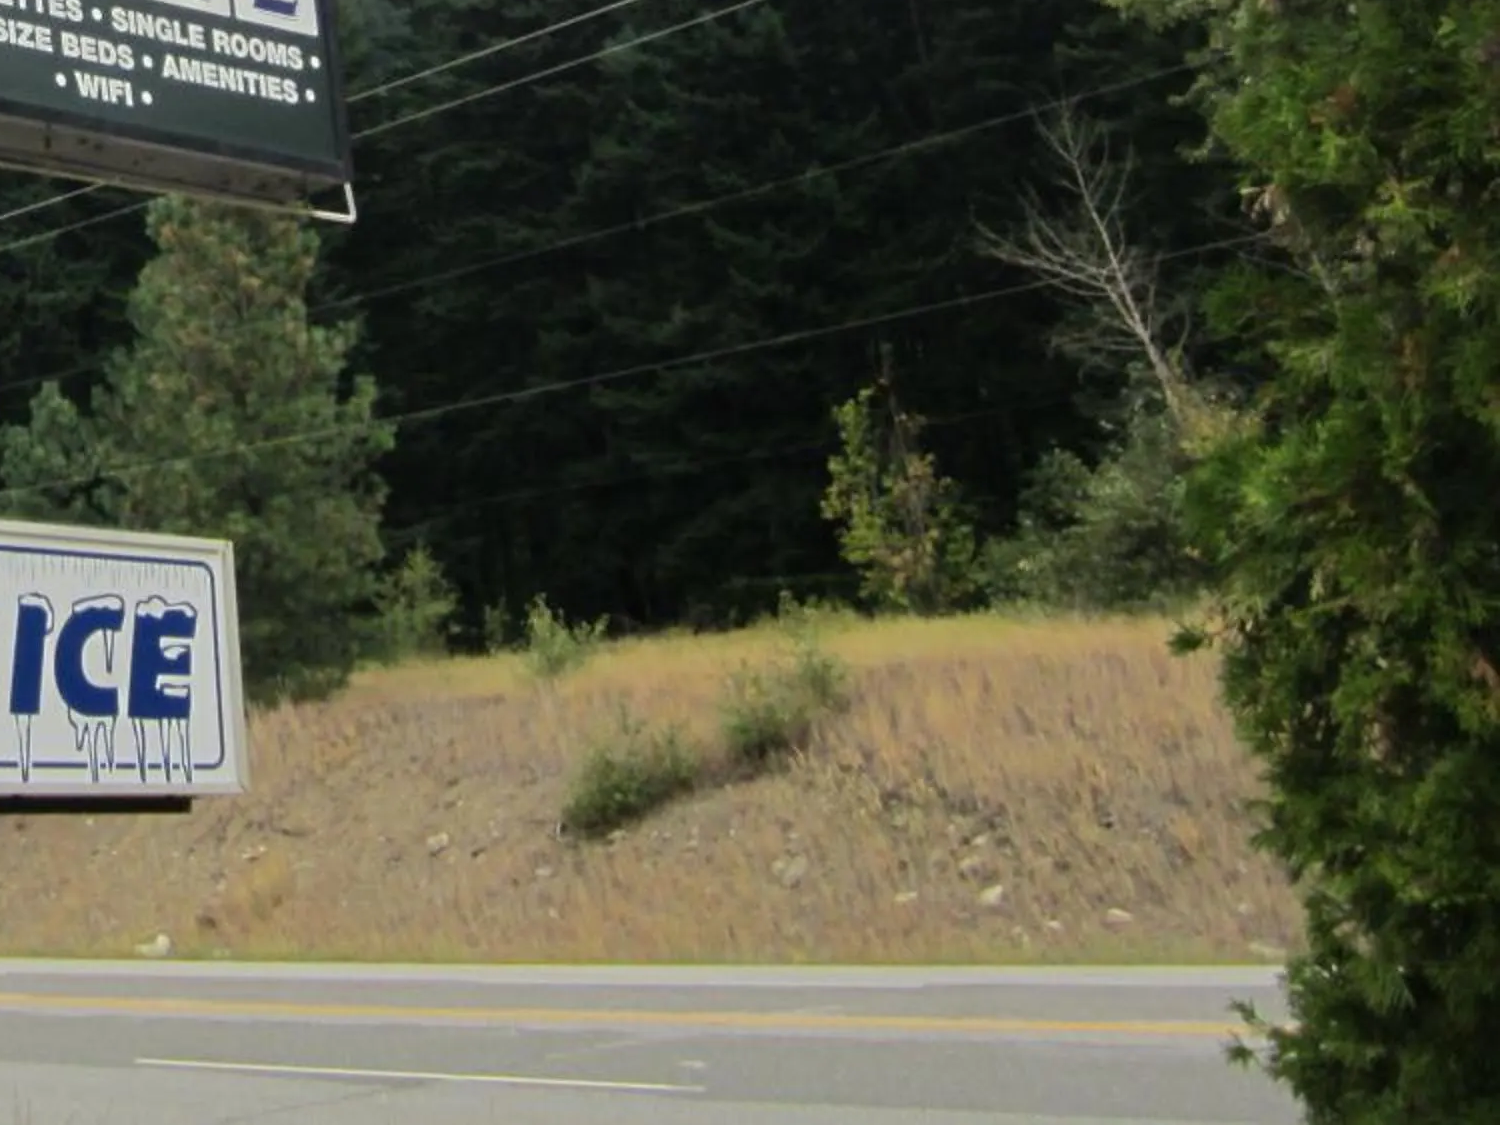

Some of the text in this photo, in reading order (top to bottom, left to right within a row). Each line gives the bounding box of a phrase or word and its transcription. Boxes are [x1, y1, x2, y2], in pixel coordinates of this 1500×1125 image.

[60, 31, 135, 70] BEDS
[161, 54, 299, 105] AMENITIES
[111, 6, 206, 50] SINGLE
[212, 28, 303, 70] ROOMS
[74, 71, 134, 107] WIFI
[9, 593, 198, 719] ICE
